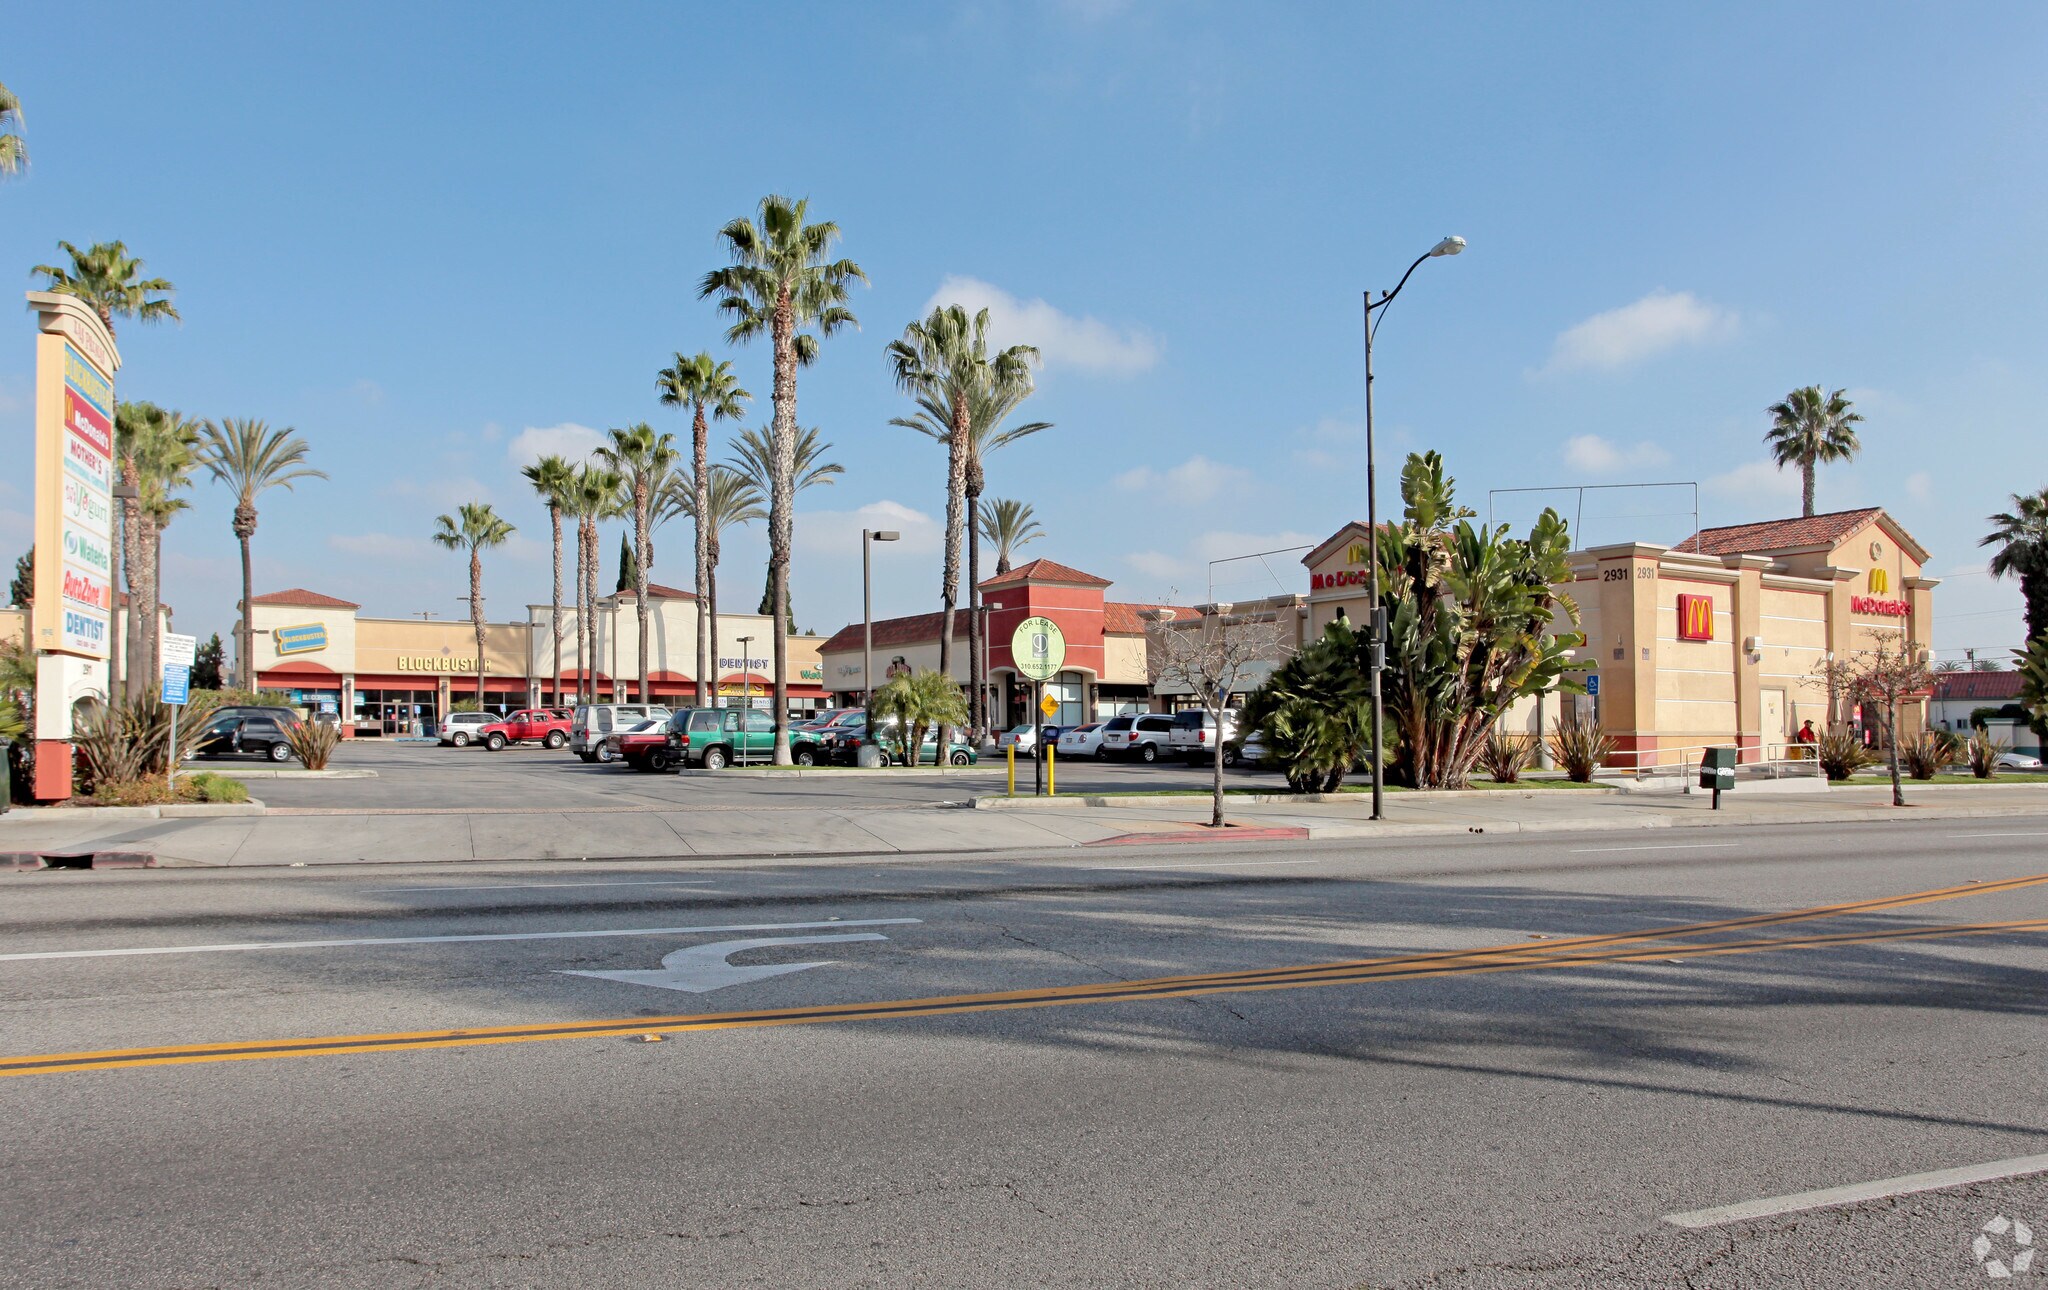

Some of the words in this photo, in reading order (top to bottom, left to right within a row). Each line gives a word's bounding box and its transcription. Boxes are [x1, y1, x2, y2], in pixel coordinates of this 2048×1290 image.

[65, 350, 112, 412] BLOCKBUSTER
[74, 409, 109, 451] McDonald's
[71, 438, 103, 475] MOTHER'S
[79, 535, 108, 571] Wateria
[1603, 568, 1628, 582] 2931
[1637, 566, 1654, 579] 2931
[62, 570, 100, 606] AutoZone
[1851, 595, 1911, 616] McDonald's
[66, 611, 104, 641] DENTIST
[284, 631, 326, 644] BLOCKBUSTER
[1018, 619, 1034, 634] FOR
[1035, 619, 1058, 635] LEASE
